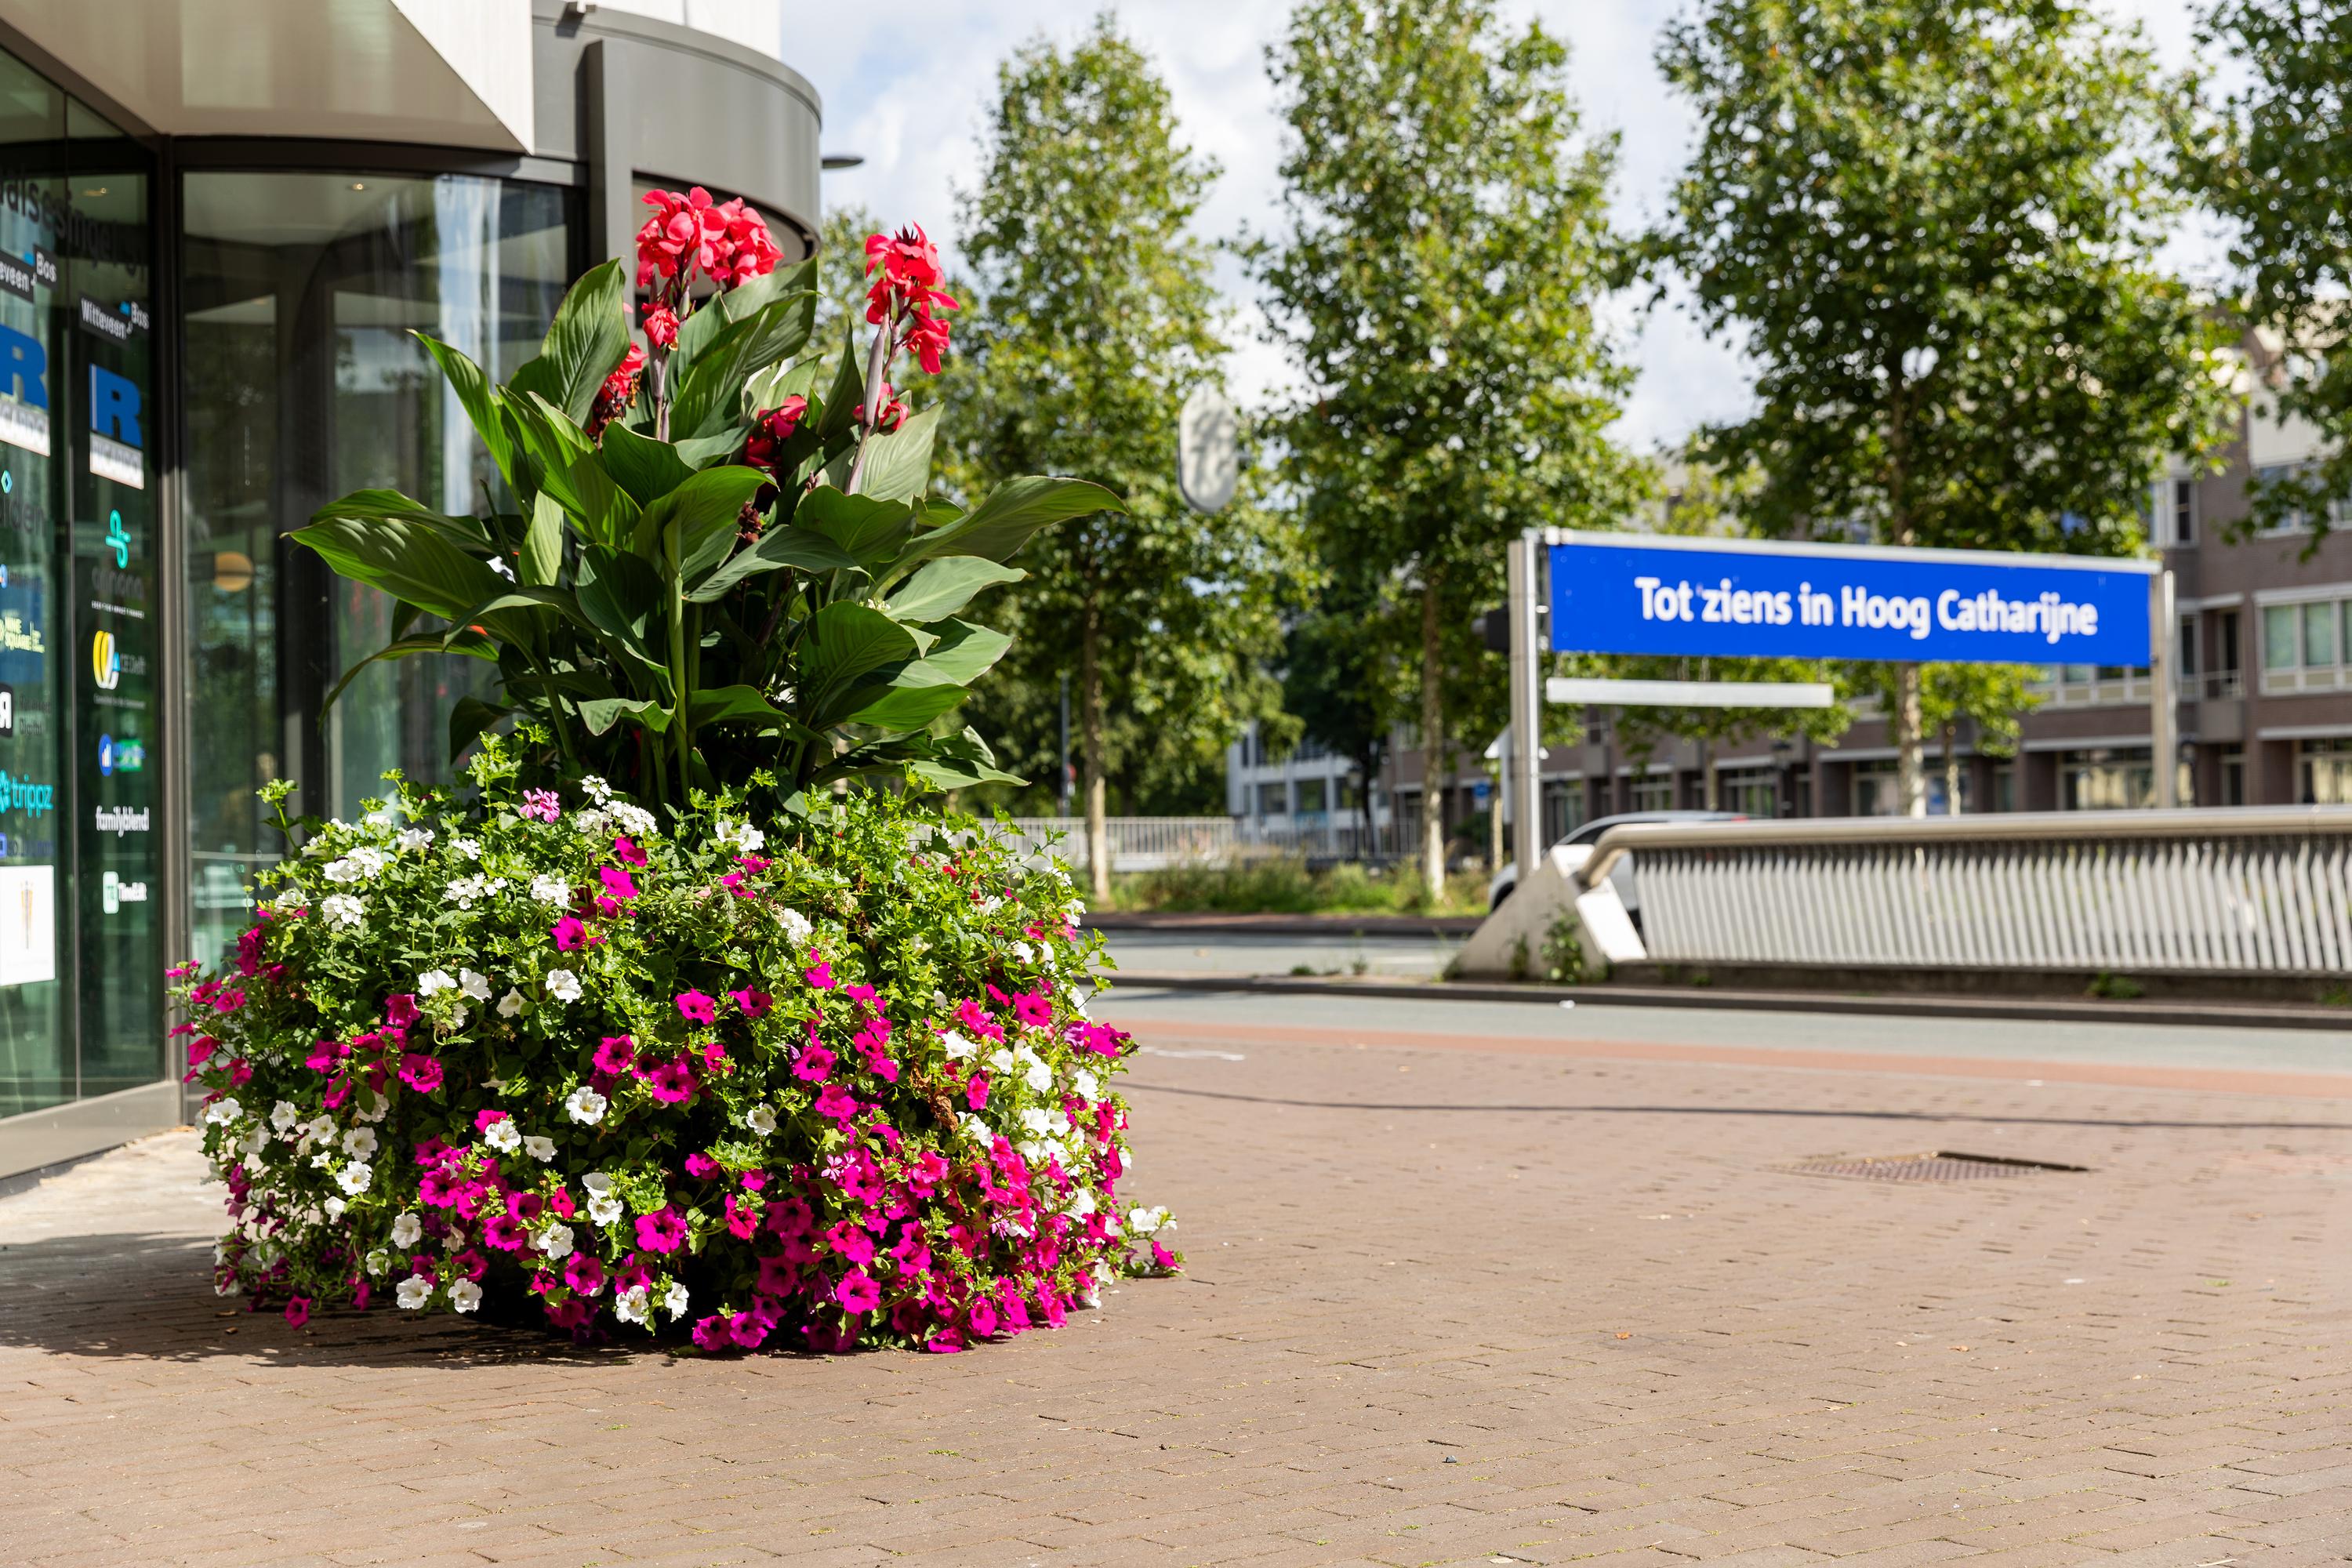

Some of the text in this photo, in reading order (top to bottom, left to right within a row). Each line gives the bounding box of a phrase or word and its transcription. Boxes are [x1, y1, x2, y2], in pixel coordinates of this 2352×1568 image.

[35, 252, 56, 282] Bos
[81, 296, 127, 339] Witteveen
[89, 363, 143, 448] R
[1634, 576, 2099, 644] Tot ziens in Hoog Catharijne
[11, 774, 54, 818] trippz
[96, 805, 150, 837] familyblend
